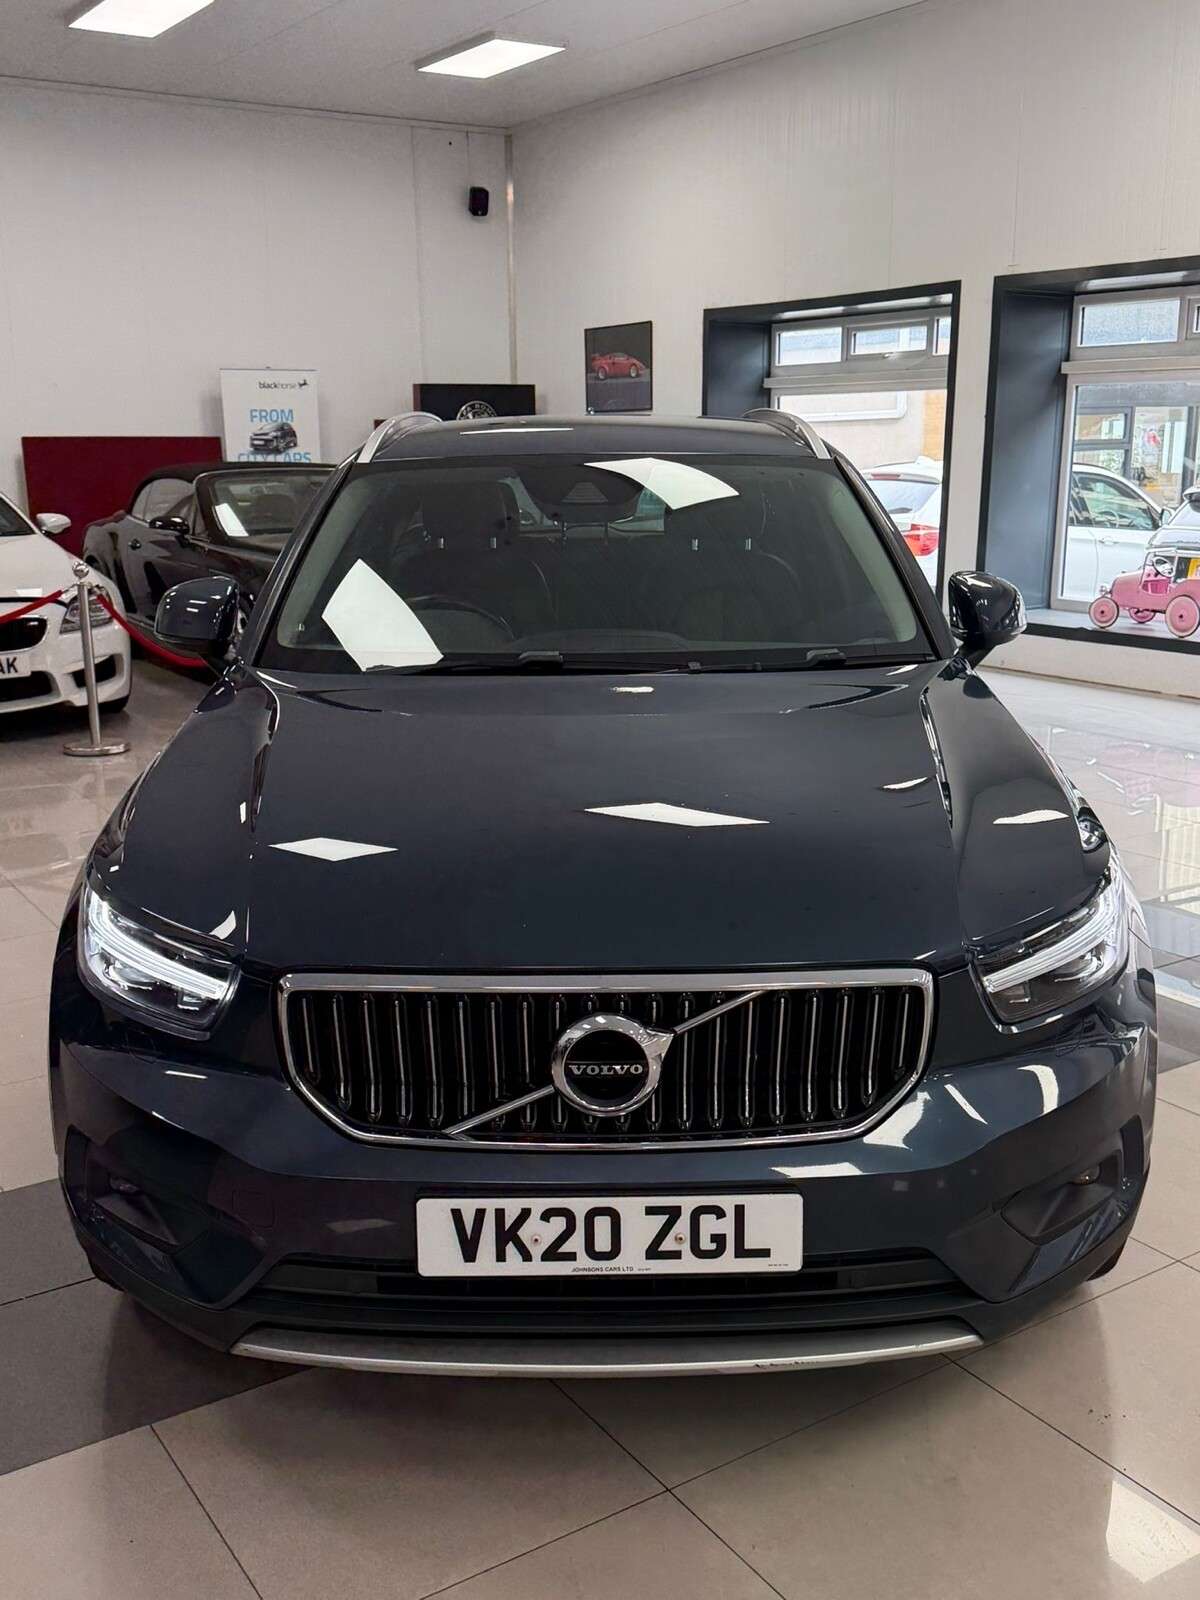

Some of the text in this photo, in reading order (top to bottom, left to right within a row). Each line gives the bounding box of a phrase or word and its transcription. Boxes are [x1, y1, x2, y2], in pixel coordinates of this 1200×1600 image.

[258, 380, 297, 390] blackhorse
[249, 408, 294, 423] FROM
[568, 1064, 643, 1076] VOLVO
[450, 1204, 772, 1264] VK20 ZGL
